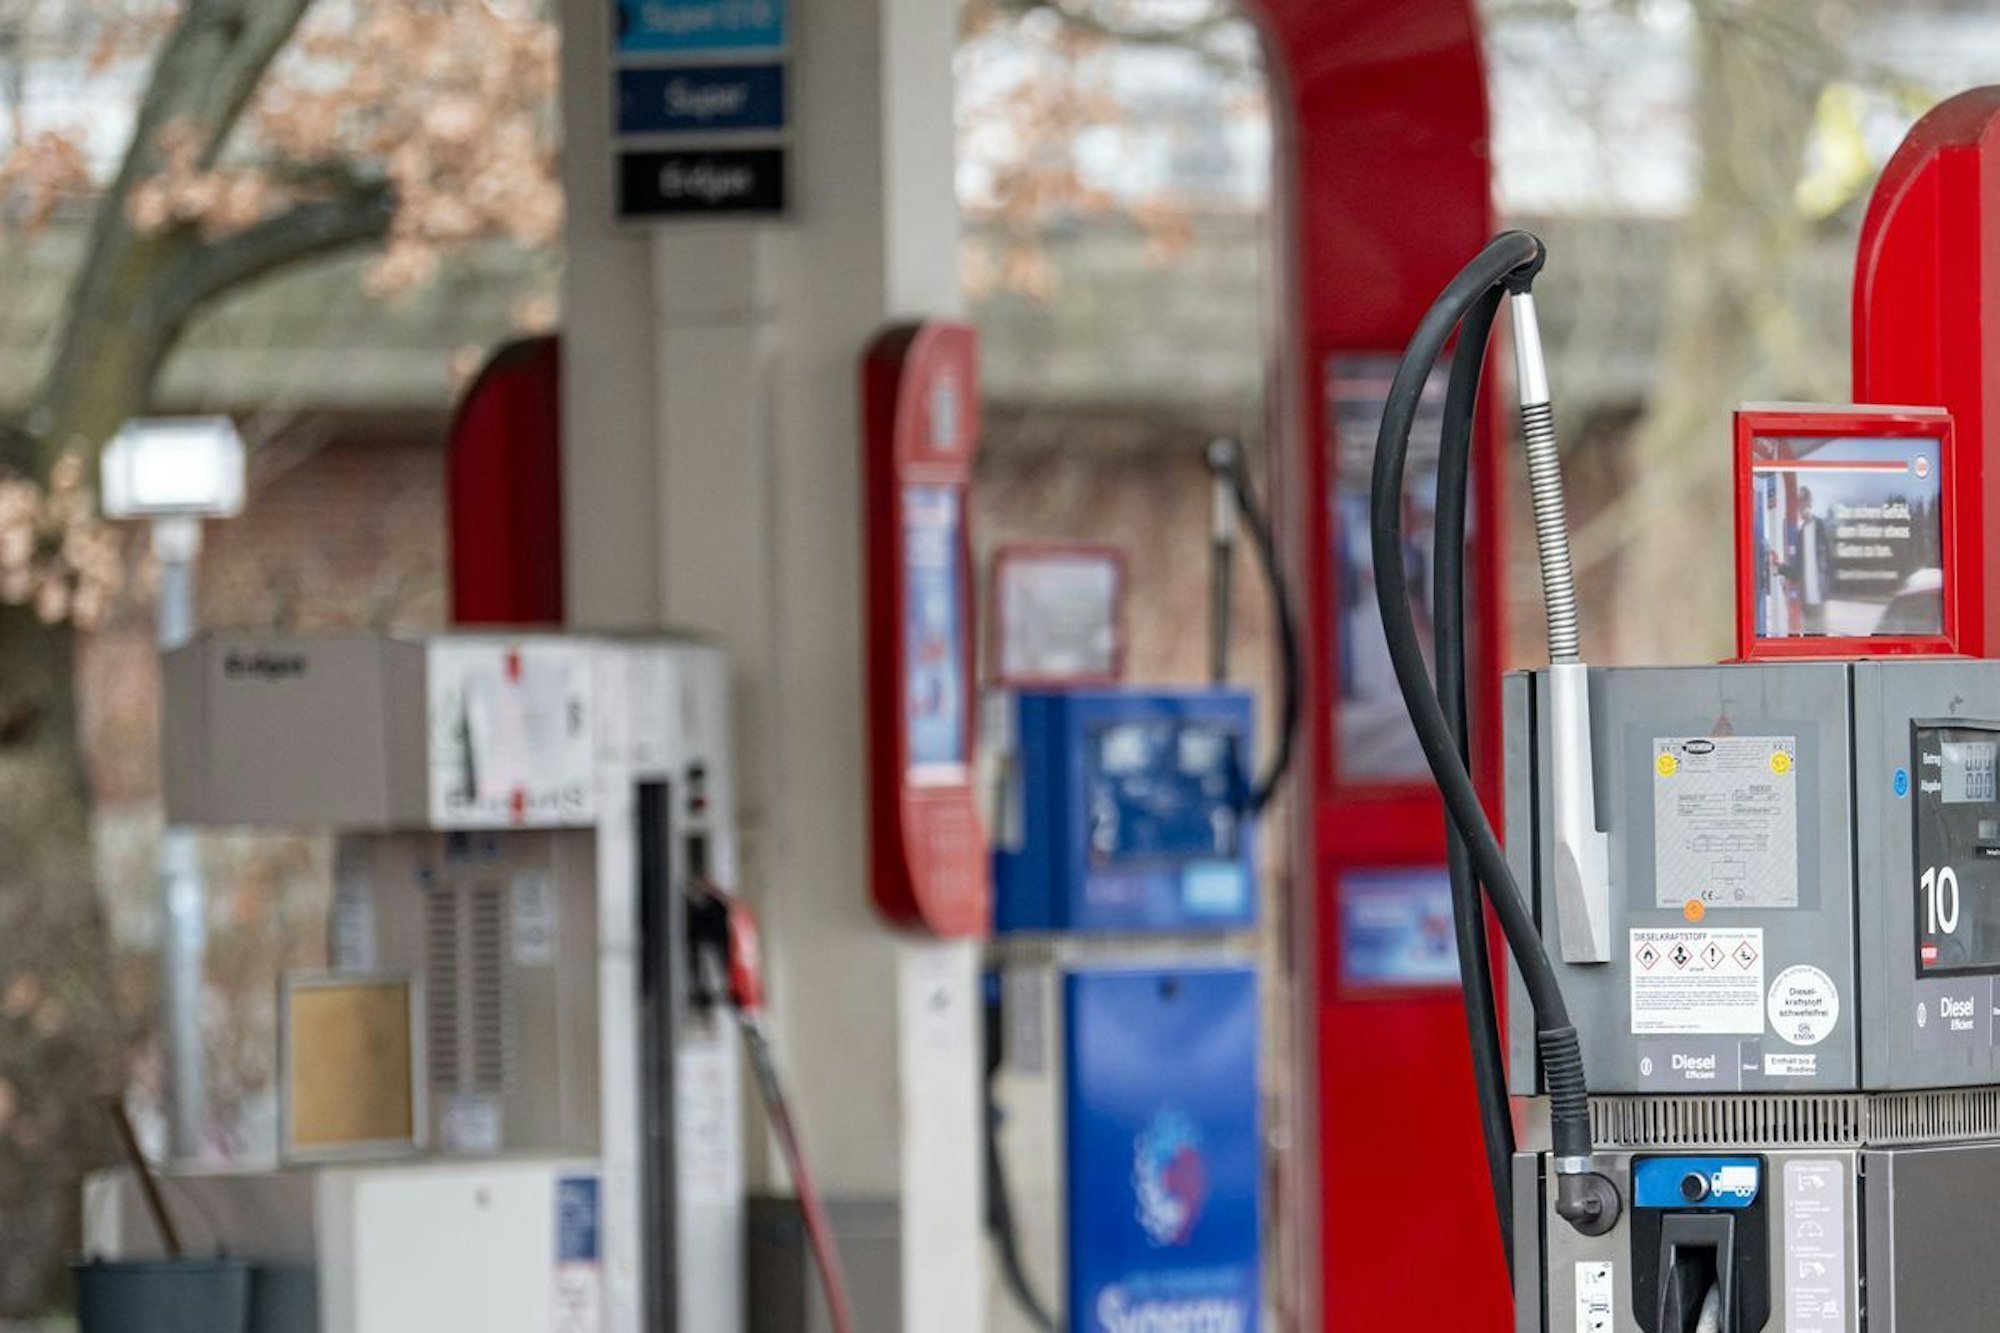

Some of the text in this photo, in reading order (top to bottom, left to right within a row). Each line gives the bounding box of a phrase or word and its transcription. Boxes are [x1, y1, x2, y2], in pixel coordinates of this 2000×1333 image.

[664, 77, 748, 120] Super
[658, 161, 755, 203] Erdgas
[1920, 865, 1959, 934] 10
[1633, 932, 1707, 941] DIESELKRAFTSTOFF
[1789, 987, 1817, 996] Diesel-
[1785, 998, 1822, 1007] kraftstoff
[1940, 996, 1974, 1018] Diesel
[1671, 1054, 1716, 1070] Diesel
